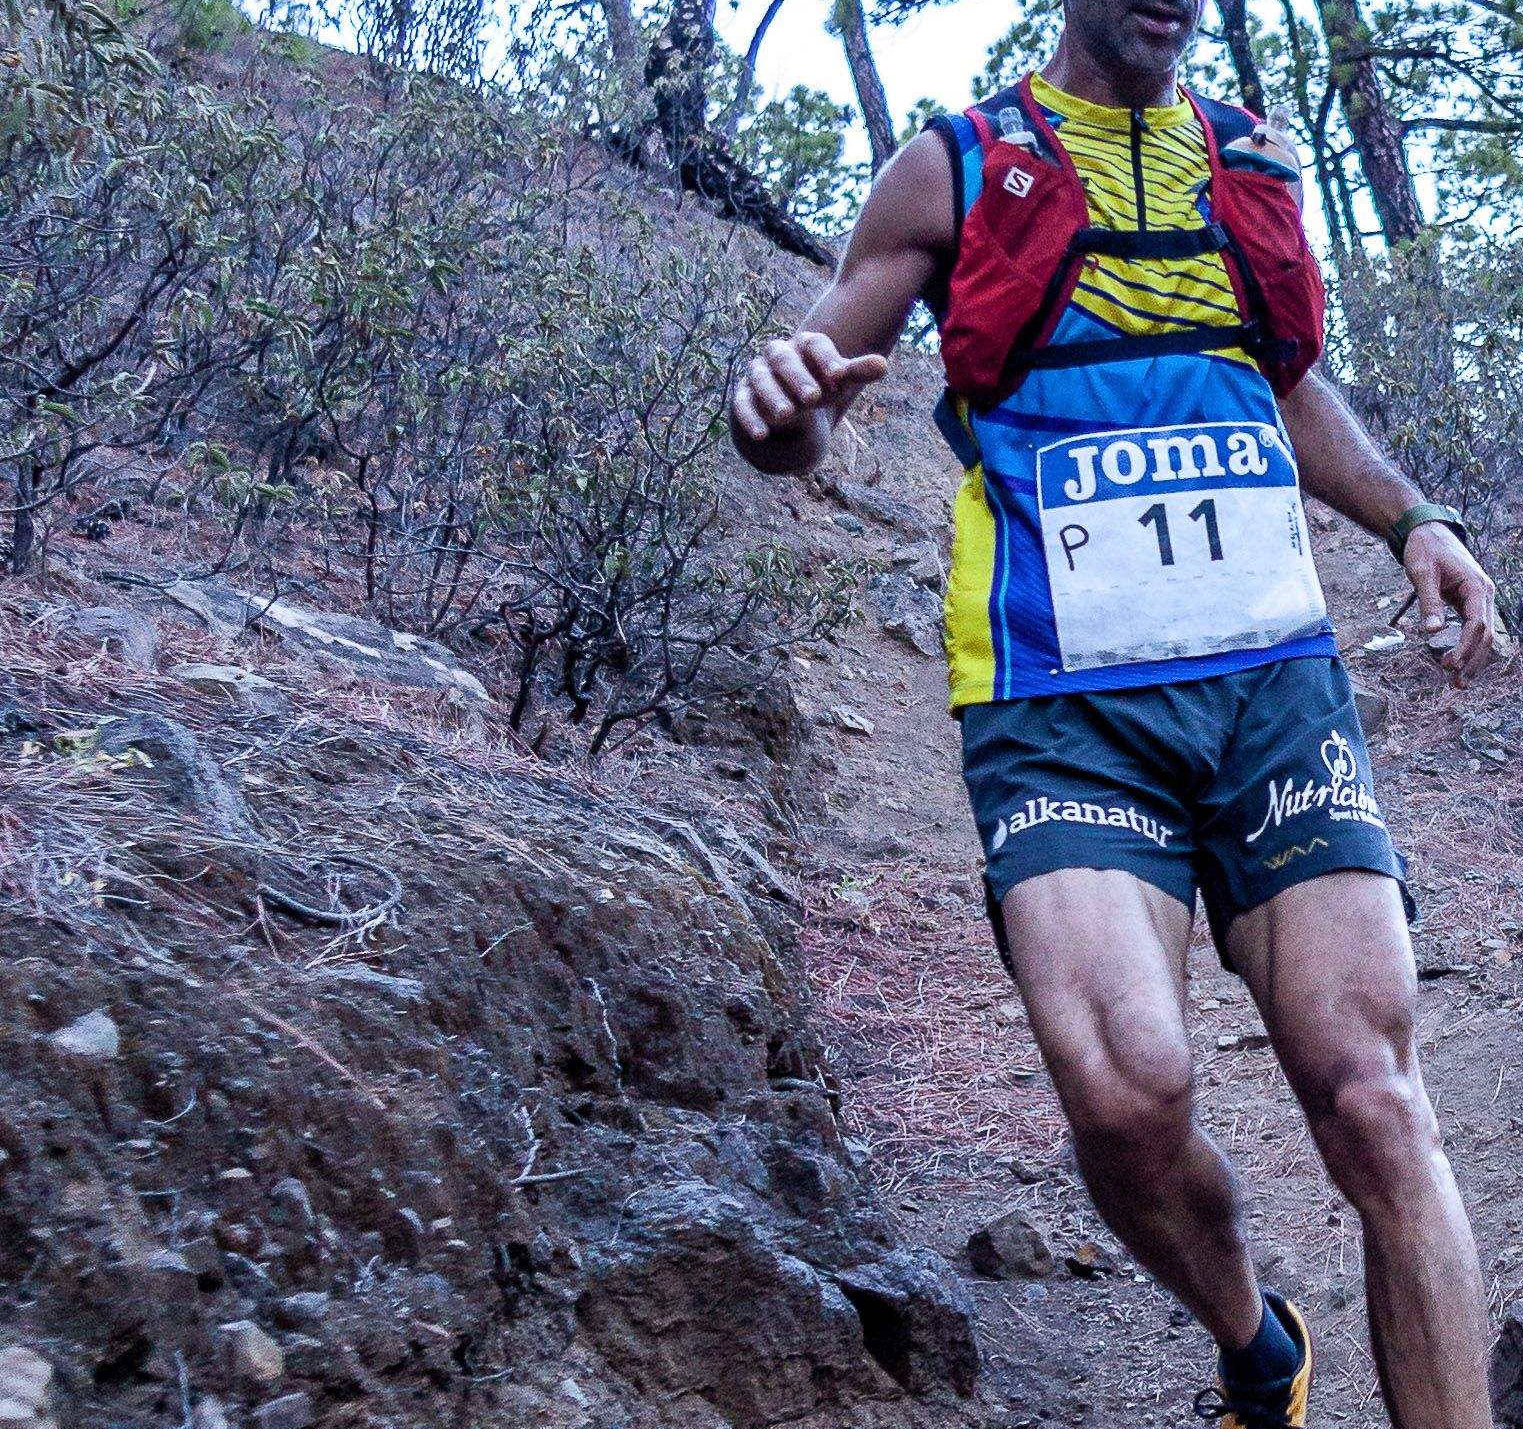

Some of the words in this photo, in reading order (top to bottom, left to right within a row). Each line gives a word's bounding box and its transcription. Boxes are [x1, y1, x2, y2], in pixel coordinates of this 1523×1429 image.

[1059, 524, 1090, 571] P
[1138, 498, 1224, 566] 11
[1009, 797, 1173, 848] alkanatur
